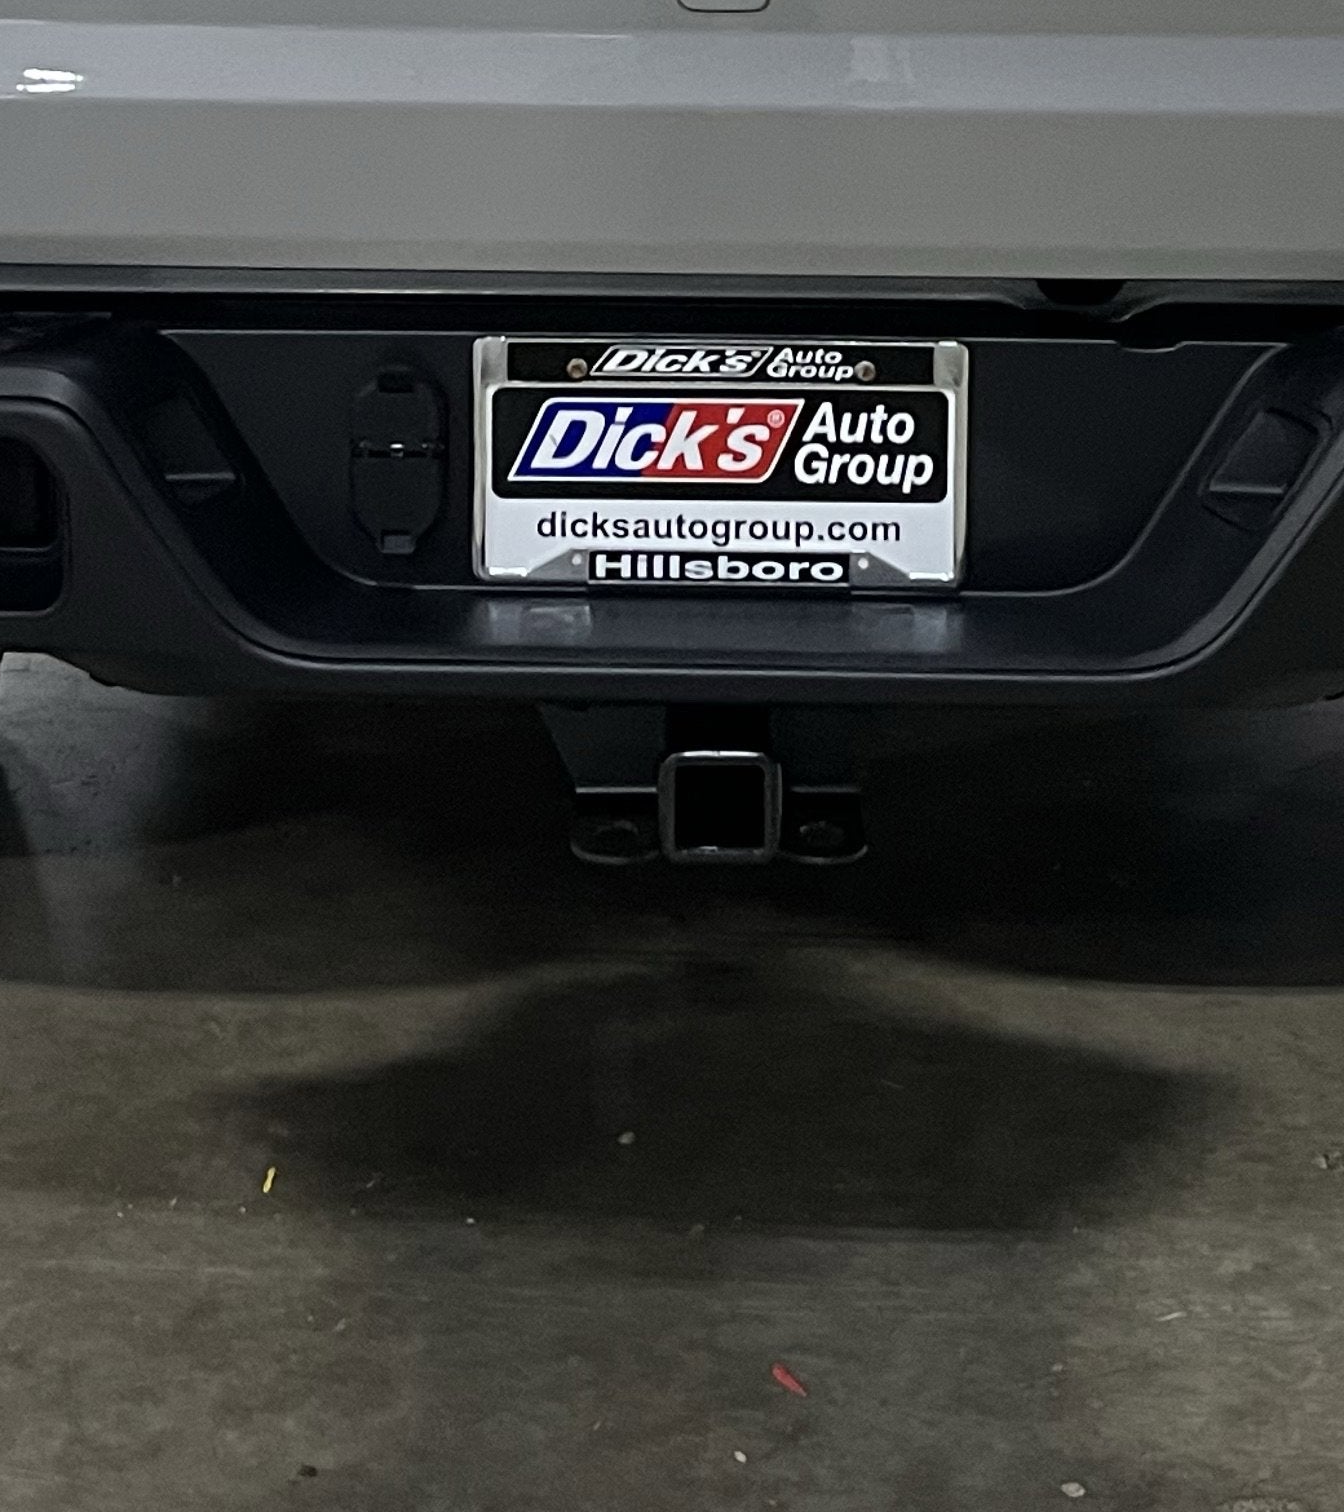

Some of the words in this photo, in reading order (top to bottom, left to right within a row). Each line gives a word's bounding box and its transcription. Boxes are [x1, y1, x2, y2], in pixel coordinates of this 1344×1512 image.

[602, 348, 753, 373] Dick's
[773, 347, 843, 364] Auto
[766, 362, 854, 381] Group
[529, 406, 769, 472] Dick's
[801, 401, 916, 444] Auto
[794, 445, 934, 493] Group
[537, 511, 901, 548] dicksautogroup.com
[595, 554, 844, 581] Hillsboro
